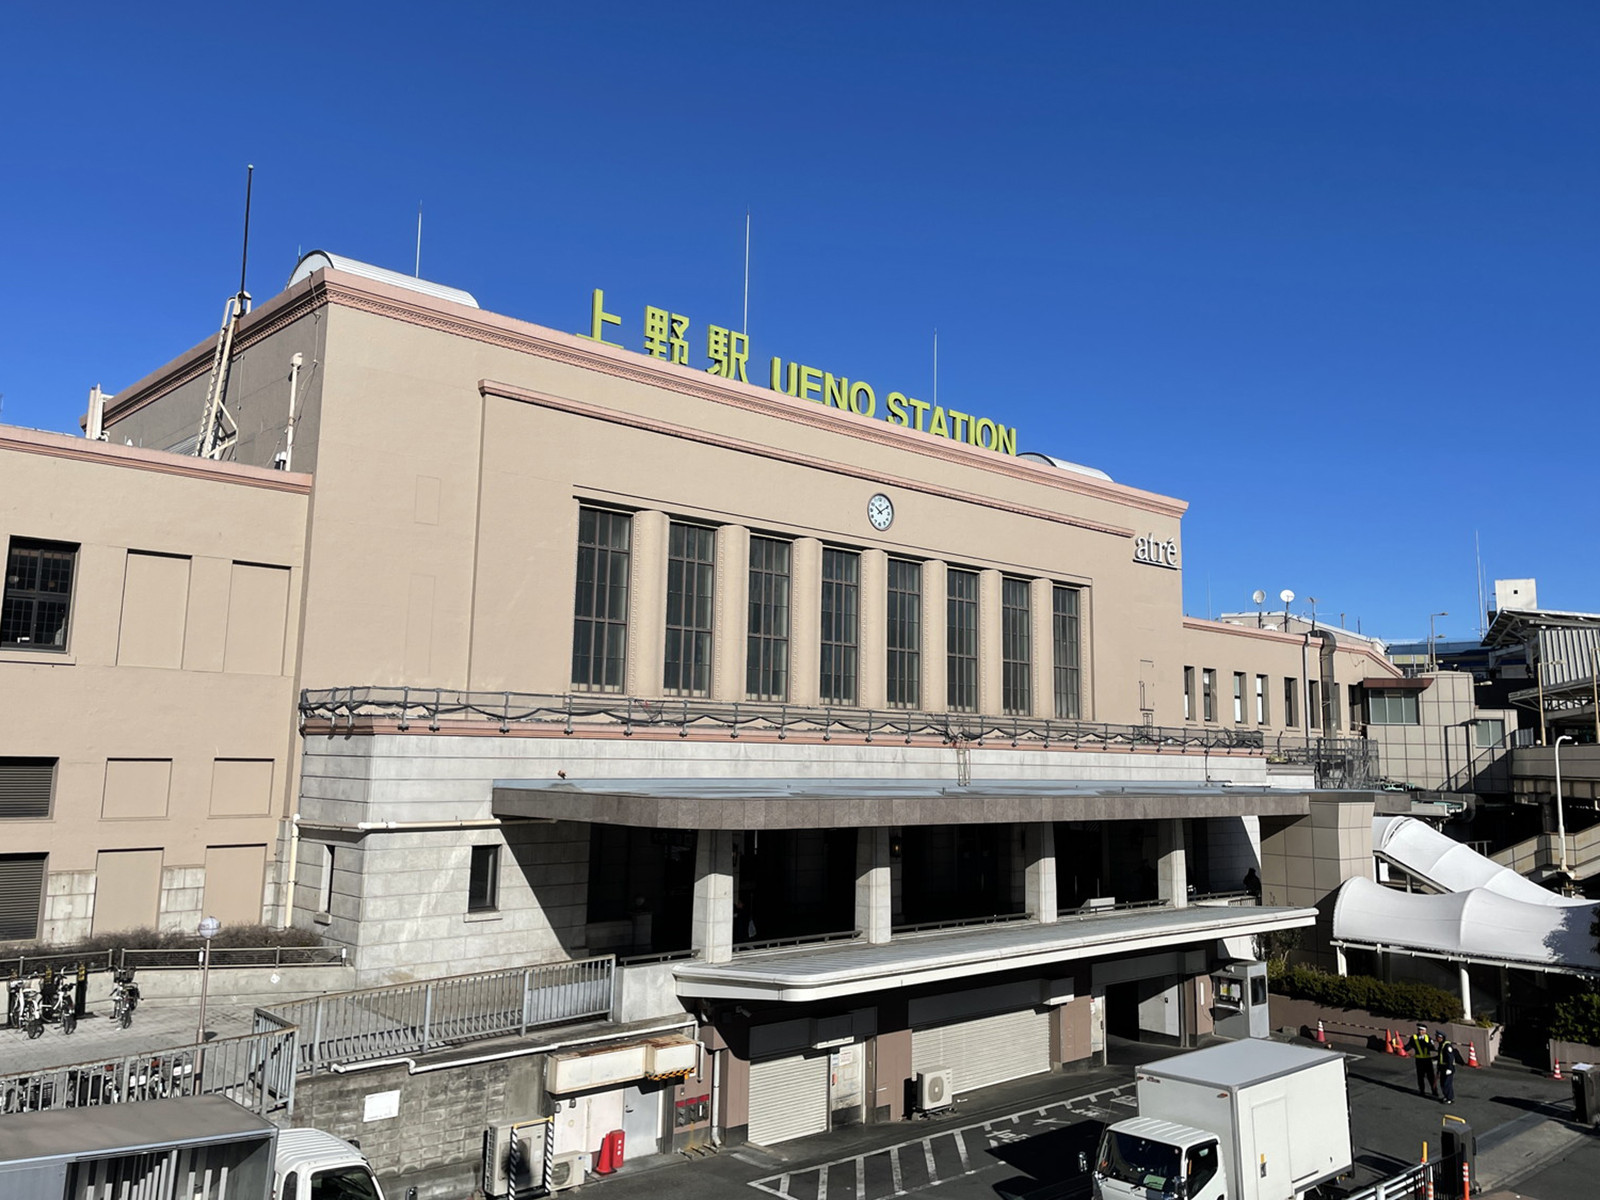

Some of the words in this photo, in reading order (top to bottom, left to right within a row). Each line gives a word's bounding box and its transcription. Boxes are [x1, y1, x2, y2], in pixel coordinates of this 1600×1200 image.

[576, 288, 750, 384] 上野駅
[771, 356, 877, 415] UENO
[886, 391, 1018, 457] STATION
[1135, 532, 1178, 566] atré
